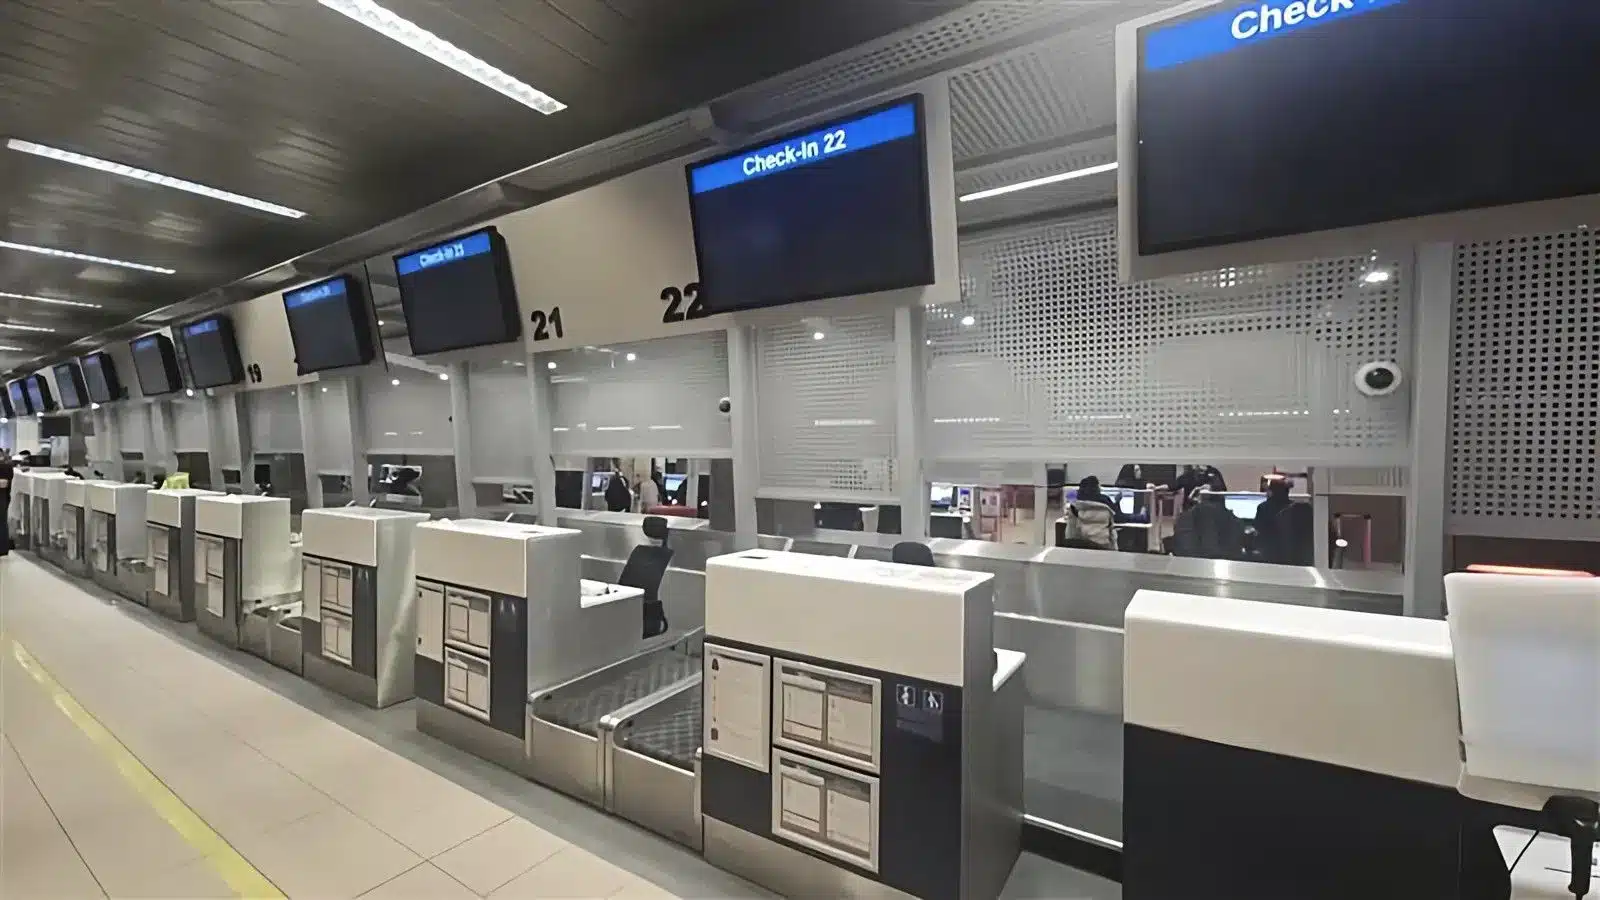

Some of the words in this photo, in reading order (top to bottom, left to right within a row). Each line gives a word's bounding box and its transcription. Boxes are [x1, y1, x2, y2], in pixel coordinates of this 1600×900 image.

[743, 141, 819, 175] Check-In
[823, 129, 847, 154] 22
[660, 282, 703, 323] 22
[530, 306, 563, 341] 21
[247, 363, 262, 383] 19
